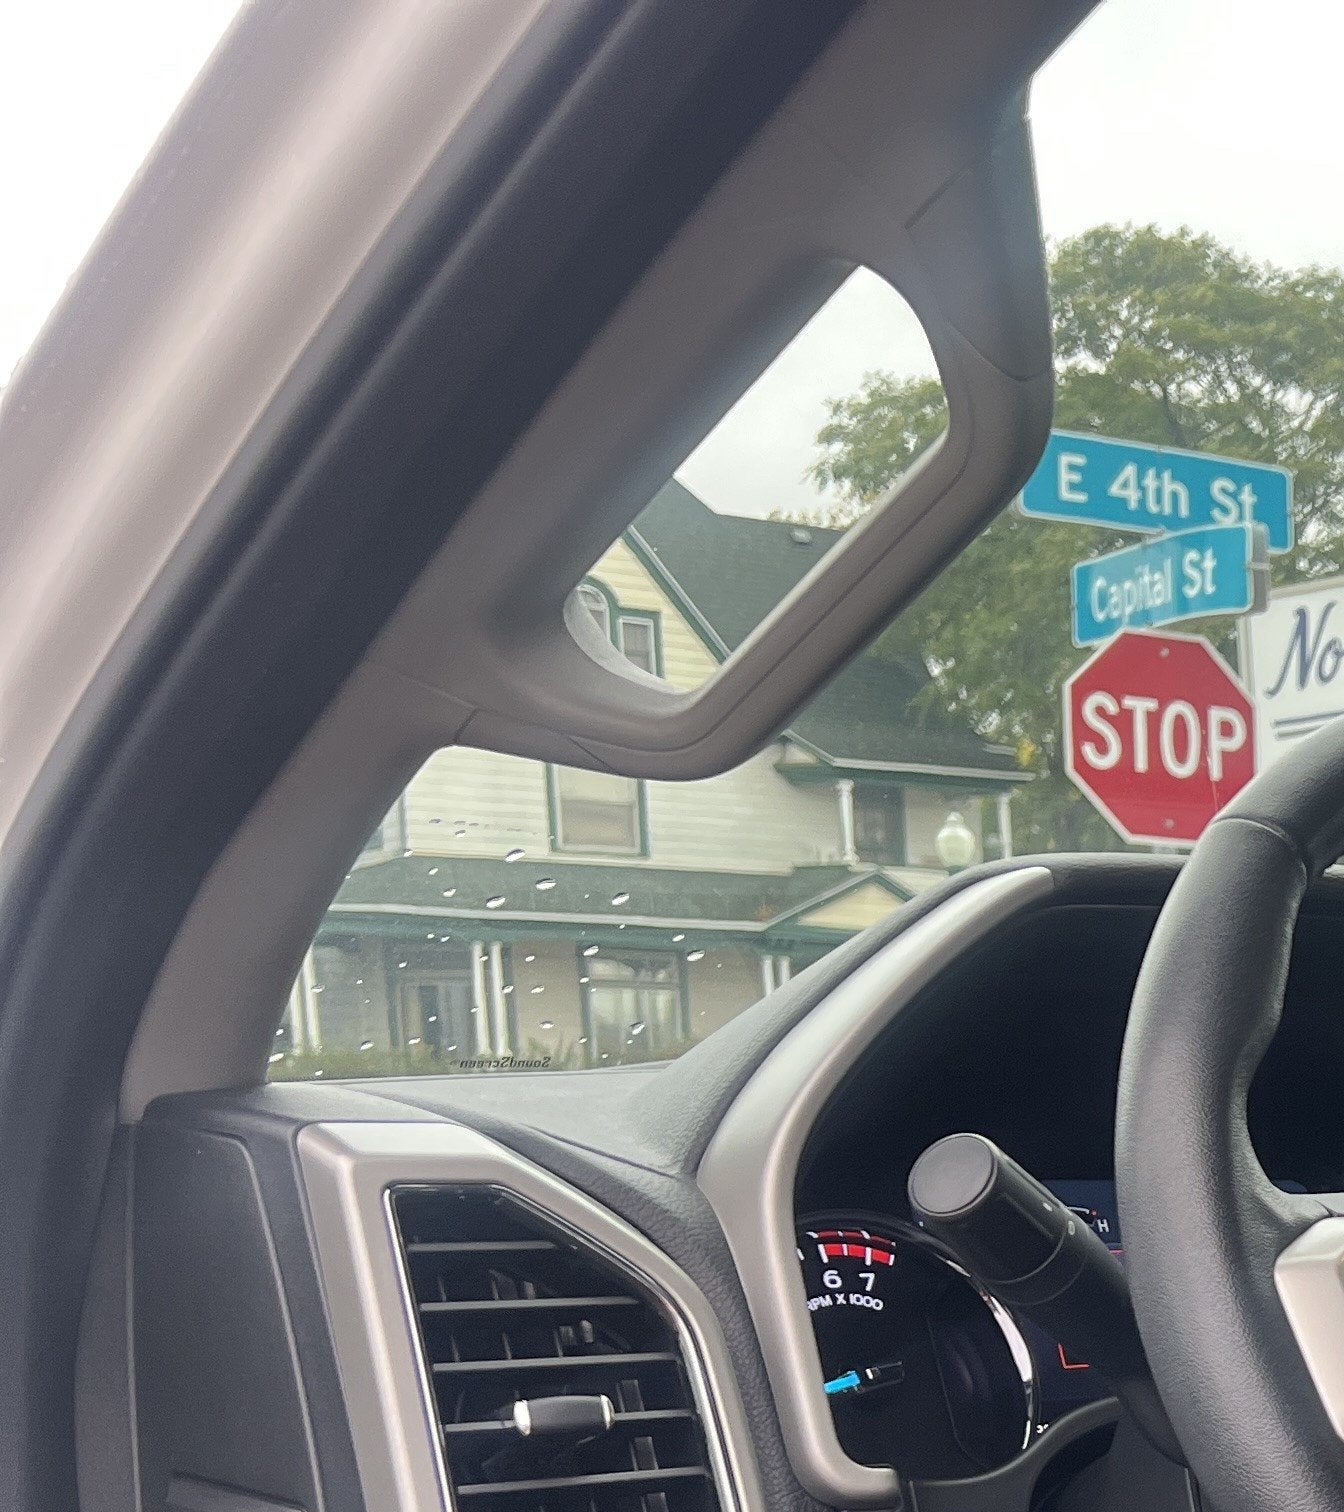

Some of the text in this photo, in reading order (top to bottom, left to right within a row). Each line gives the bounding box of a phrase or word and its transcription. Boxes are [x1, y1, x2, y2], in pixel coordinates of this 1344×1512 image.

[1057, 453, 1260, 525] E 4th St
[1090, 548, 1217, 628] Capital St
[1080, 693, 1248, 782] STOP
[1097, 1218, 1110, 1234] H
[823, 1270, 876, 1292] 6 7
[834, 1293, 847, 1306] X
[849, 1294, 884, 1312] 1000
